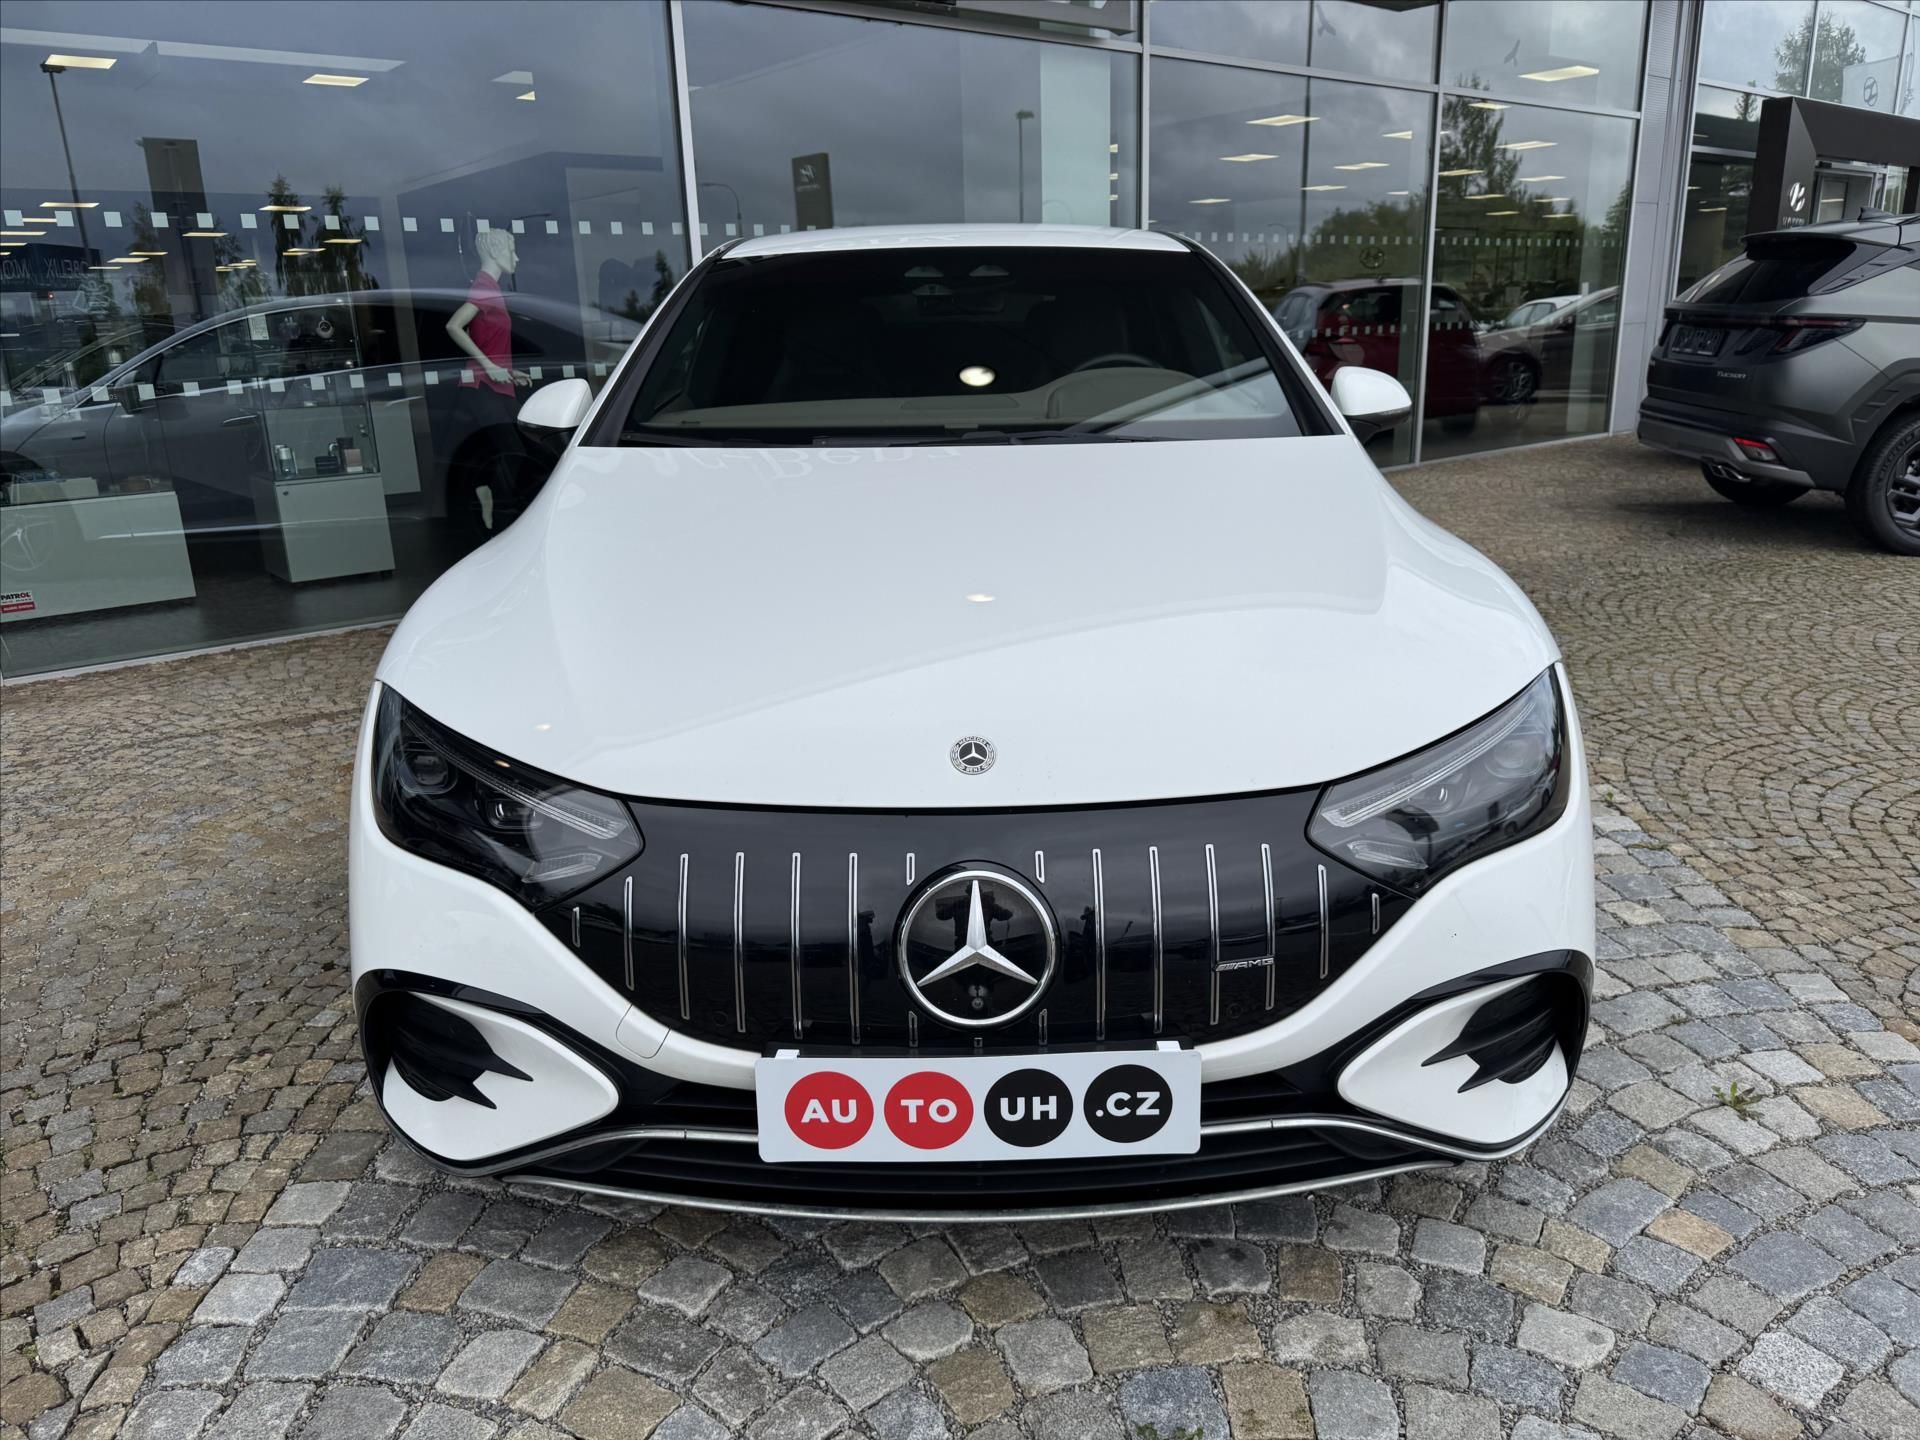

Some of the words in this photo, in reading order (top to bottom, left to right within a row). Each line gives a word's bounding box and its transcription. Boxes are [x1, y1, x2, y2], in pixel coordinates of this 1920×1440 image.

[1, 592, 31, 601] PATROL
[1232, 957, 1274, 970] AMG
[800, 1098, 857, 1124] AU
[900, 1098, 958, 1124] TO
[1000, 1095, 1057, 1122] UH
[1095, 1091, 1160, 1118] .CZ
